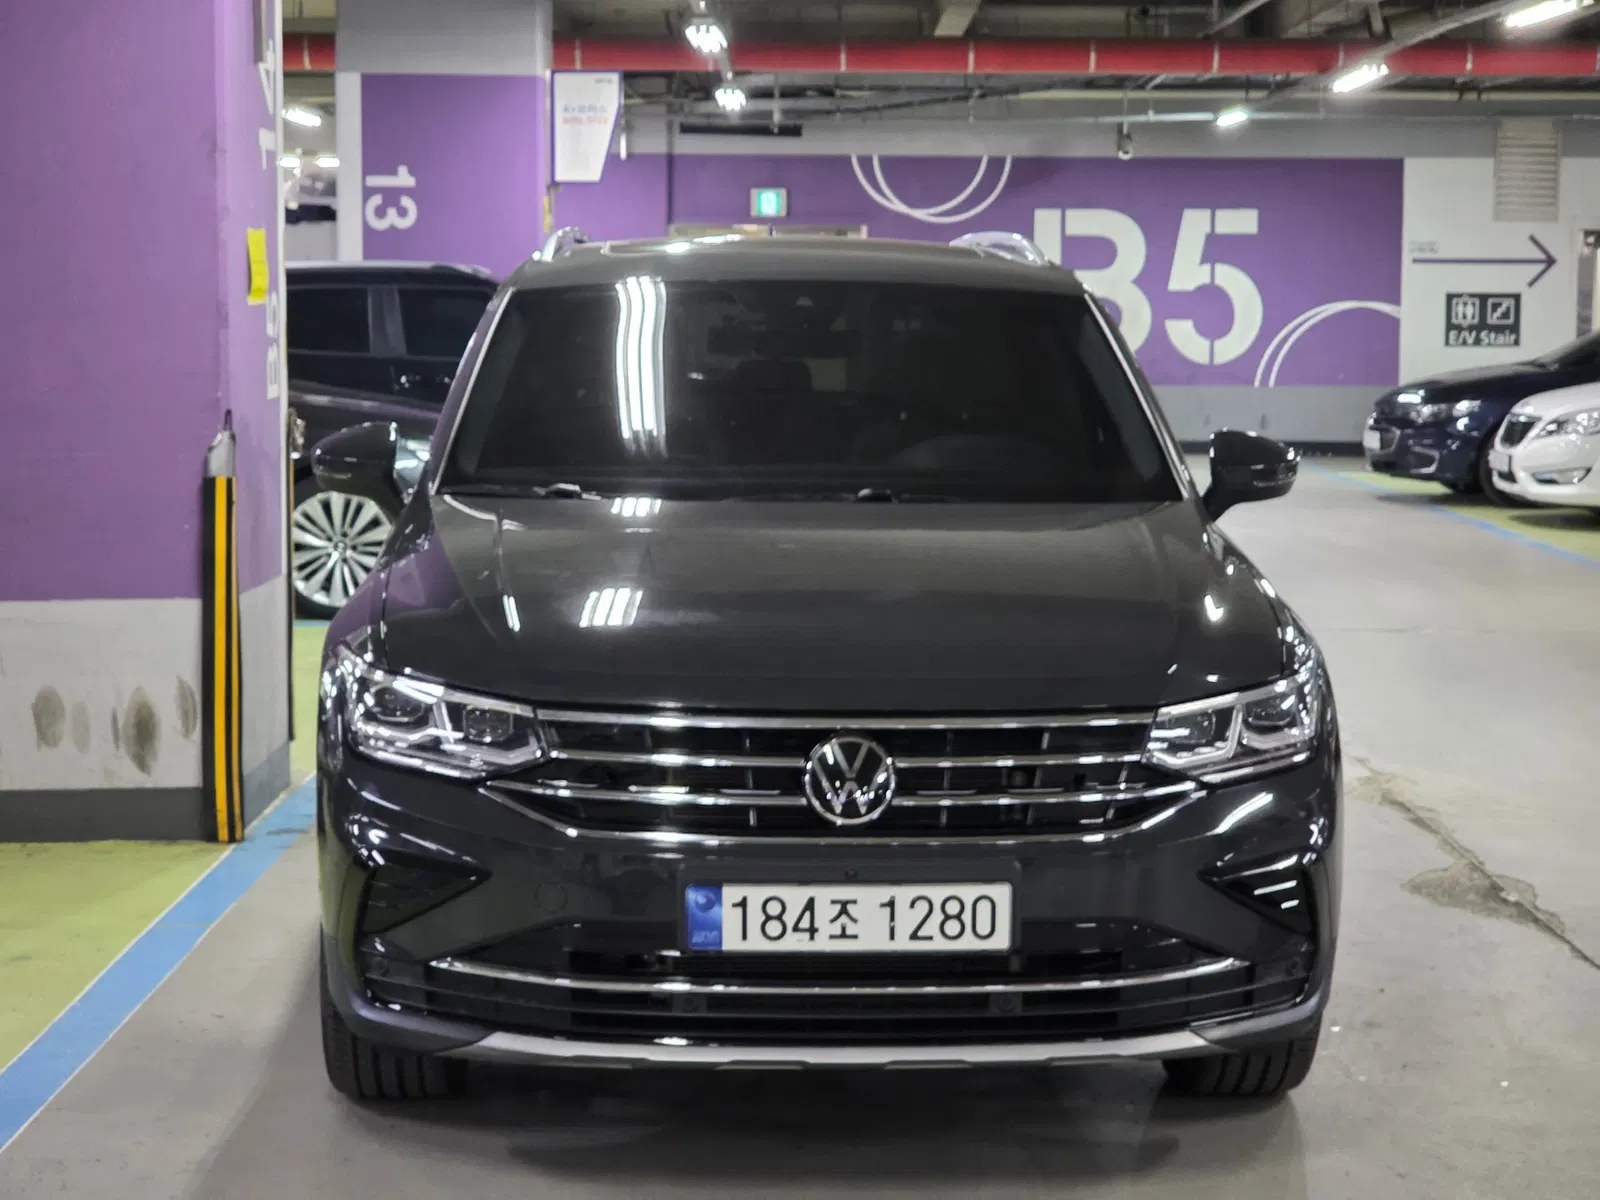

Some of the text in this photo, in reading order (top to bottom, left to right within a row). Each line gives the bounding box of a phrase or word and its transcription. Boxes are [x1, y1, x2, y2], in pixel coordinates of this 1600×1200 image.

[365, 165, 417, 231] 13
[1033, 208, 1263, 366] B5
[1448, 329, 1517, 346] E/V Stair
[731, 895, 996, 941] 184조 1280
